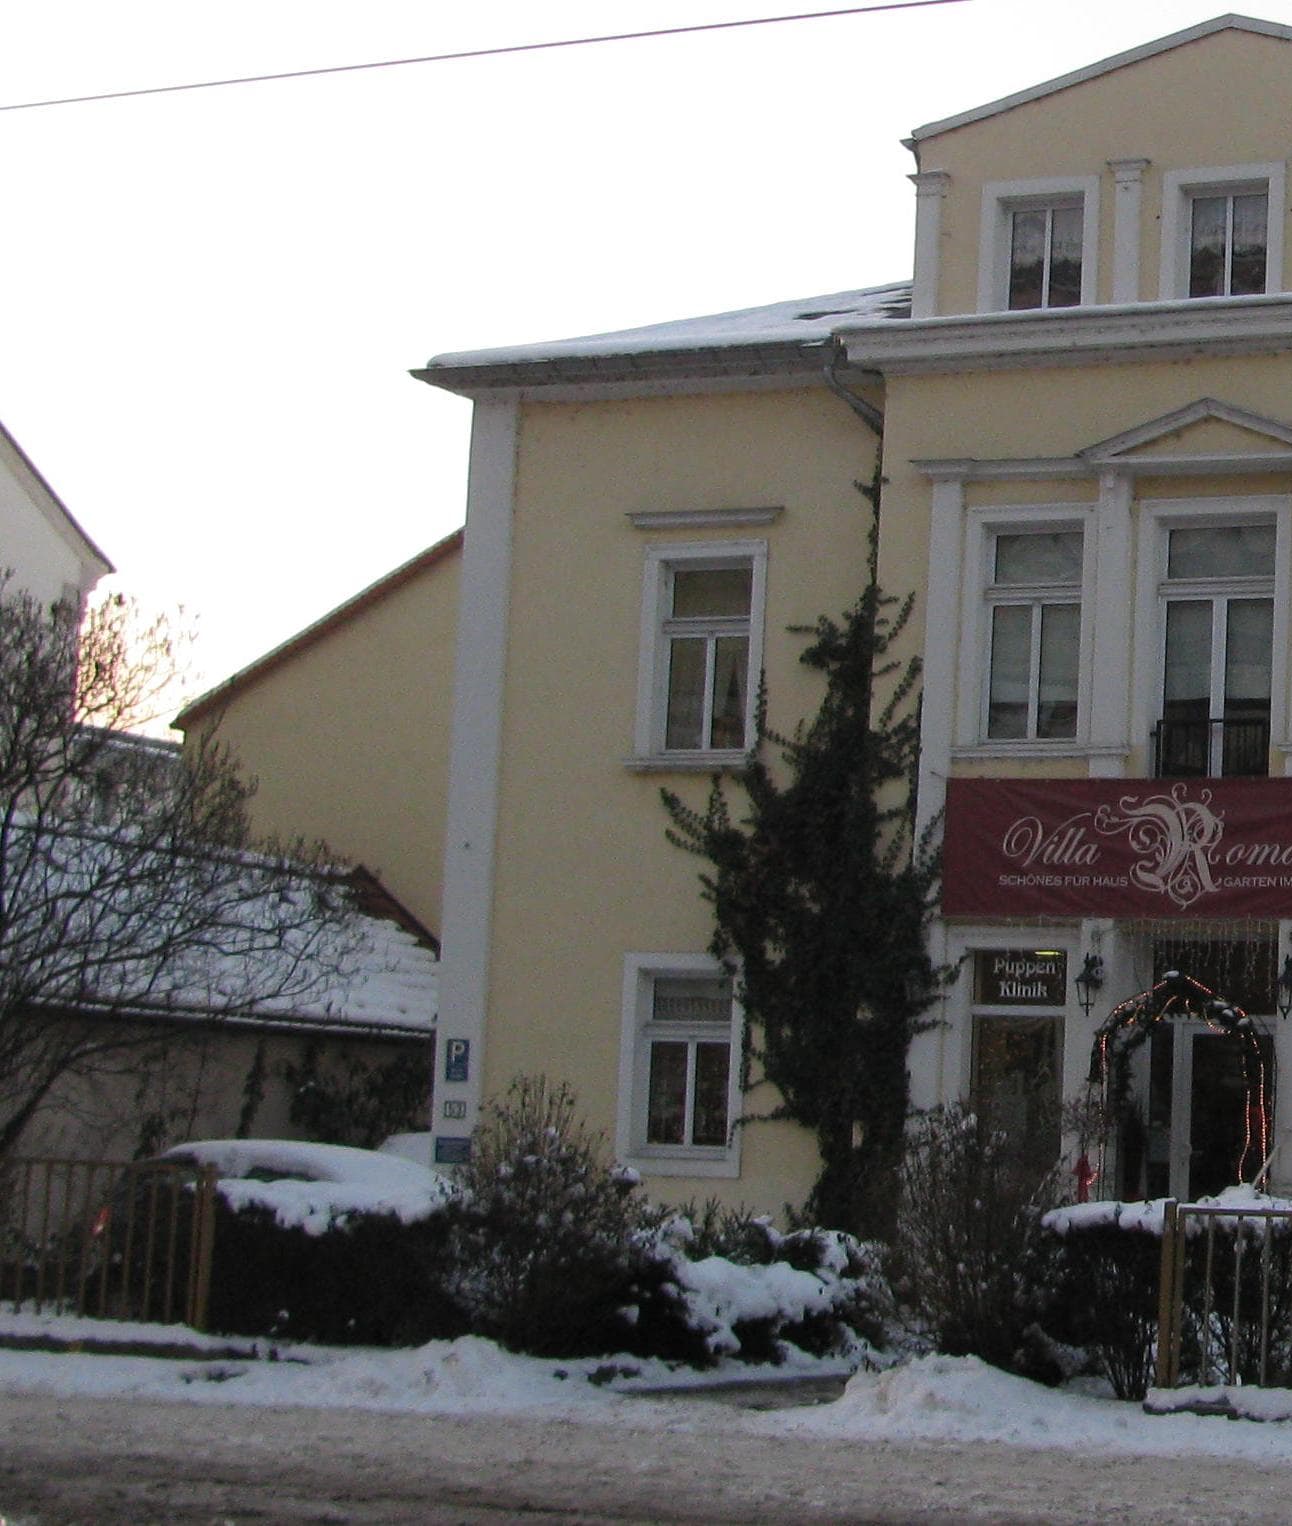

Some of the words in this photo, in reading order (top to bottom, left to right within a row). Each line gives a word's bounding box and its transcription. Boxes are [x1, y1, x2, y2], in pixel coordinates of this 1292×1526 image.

[1003, 812, 1103, 867] Villa
[998, 873, 1063, 887] SCHÖNES
[1065, 874, 1090, 887] FÜR
[1093, 875, 1128, 888] HAUS
[1223, 876, 1277, 888] GARTEN
[992, 957, 1056, 978] Puppen
[998, 981, 1048, 998] Klinik
[449, 1041, 464, 1062] P
